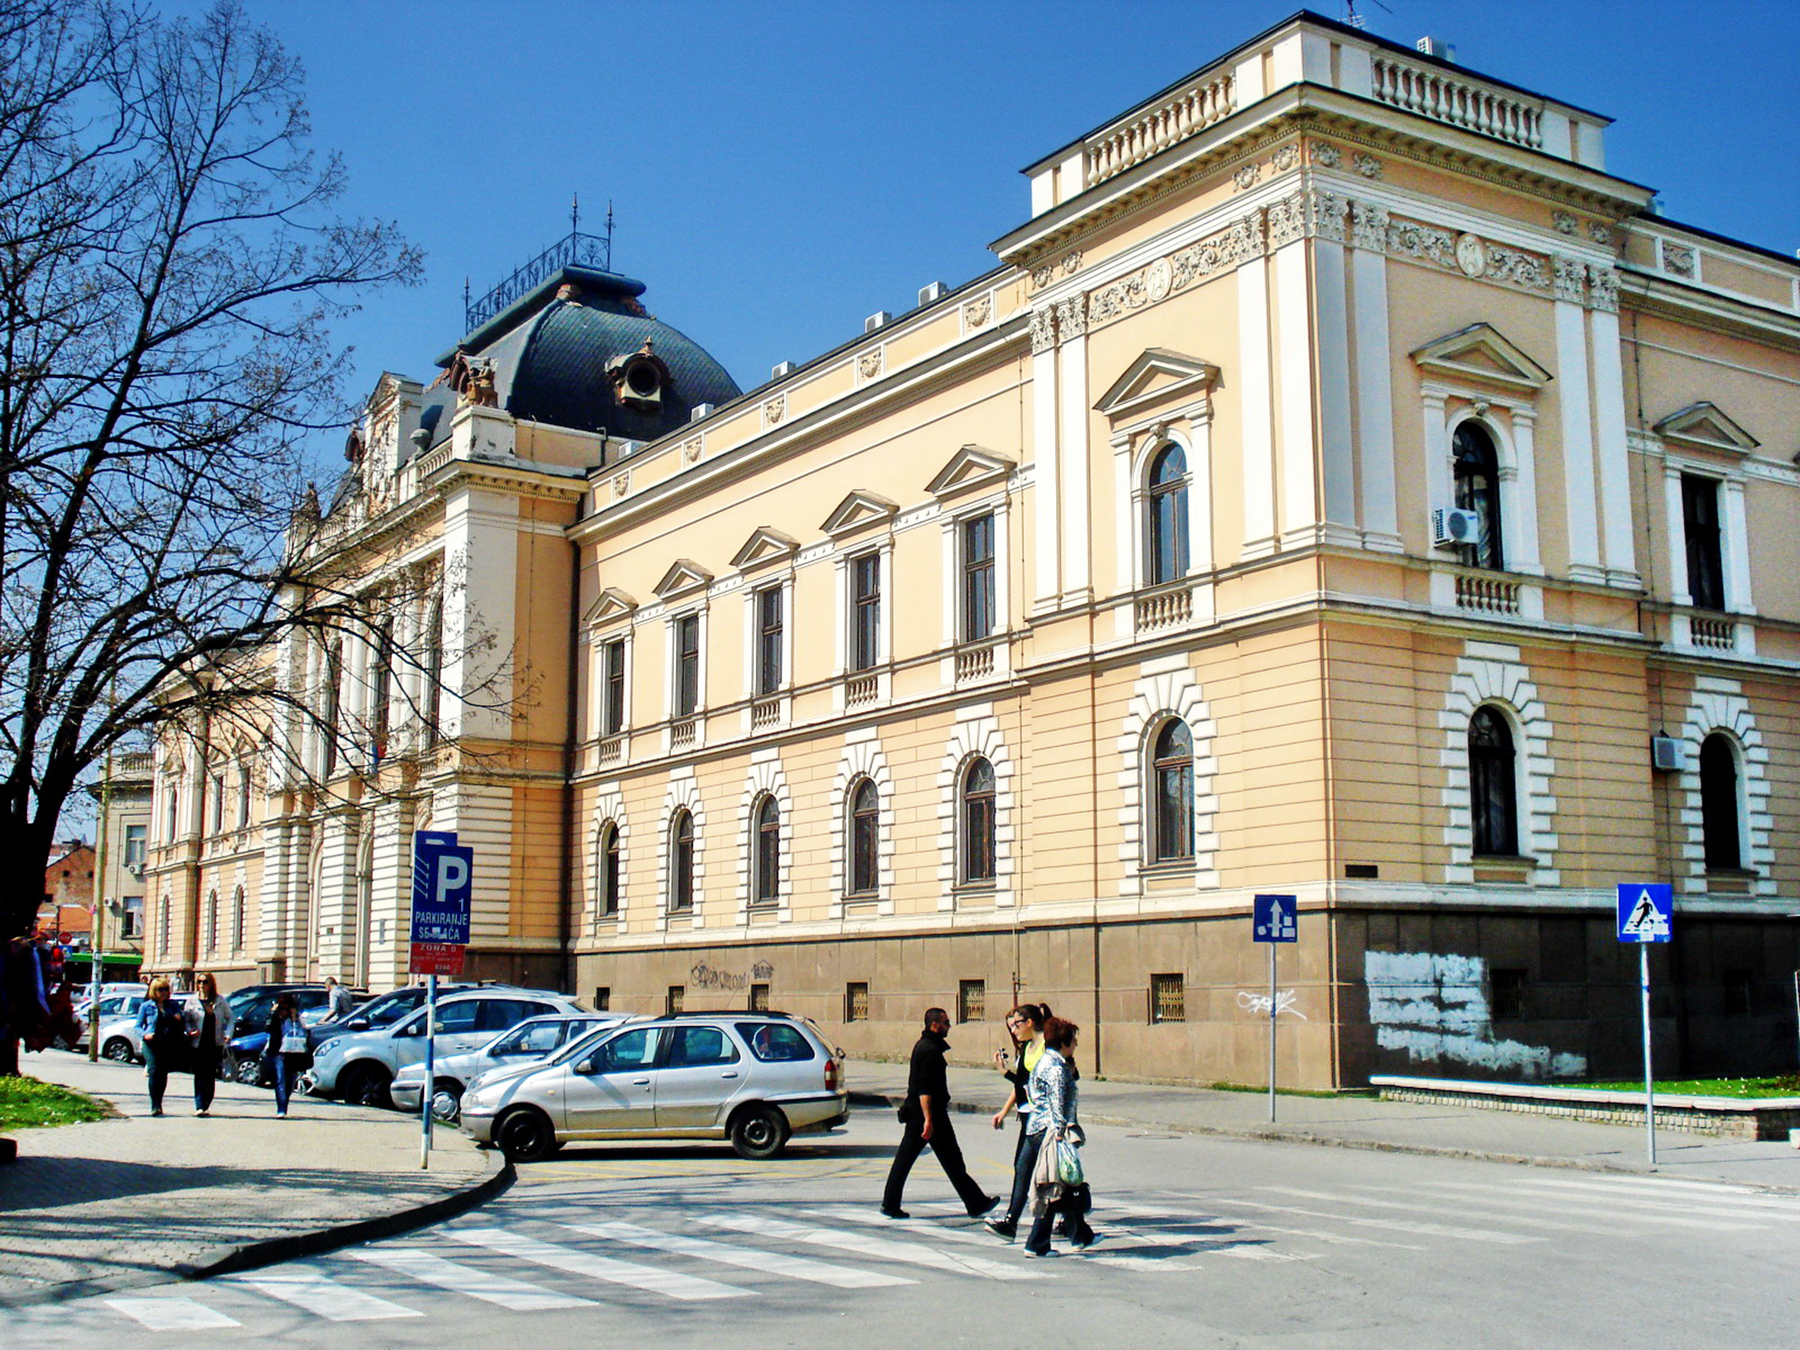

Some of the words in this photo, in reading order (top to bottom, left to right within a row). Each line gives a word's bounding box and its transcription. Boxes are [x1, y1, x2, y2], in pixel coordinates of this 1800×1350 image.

[436, 855, 468, 902] P
[458, 898, 464, 912] 1
[415, 911, 468, 925] PARKIRANJE
